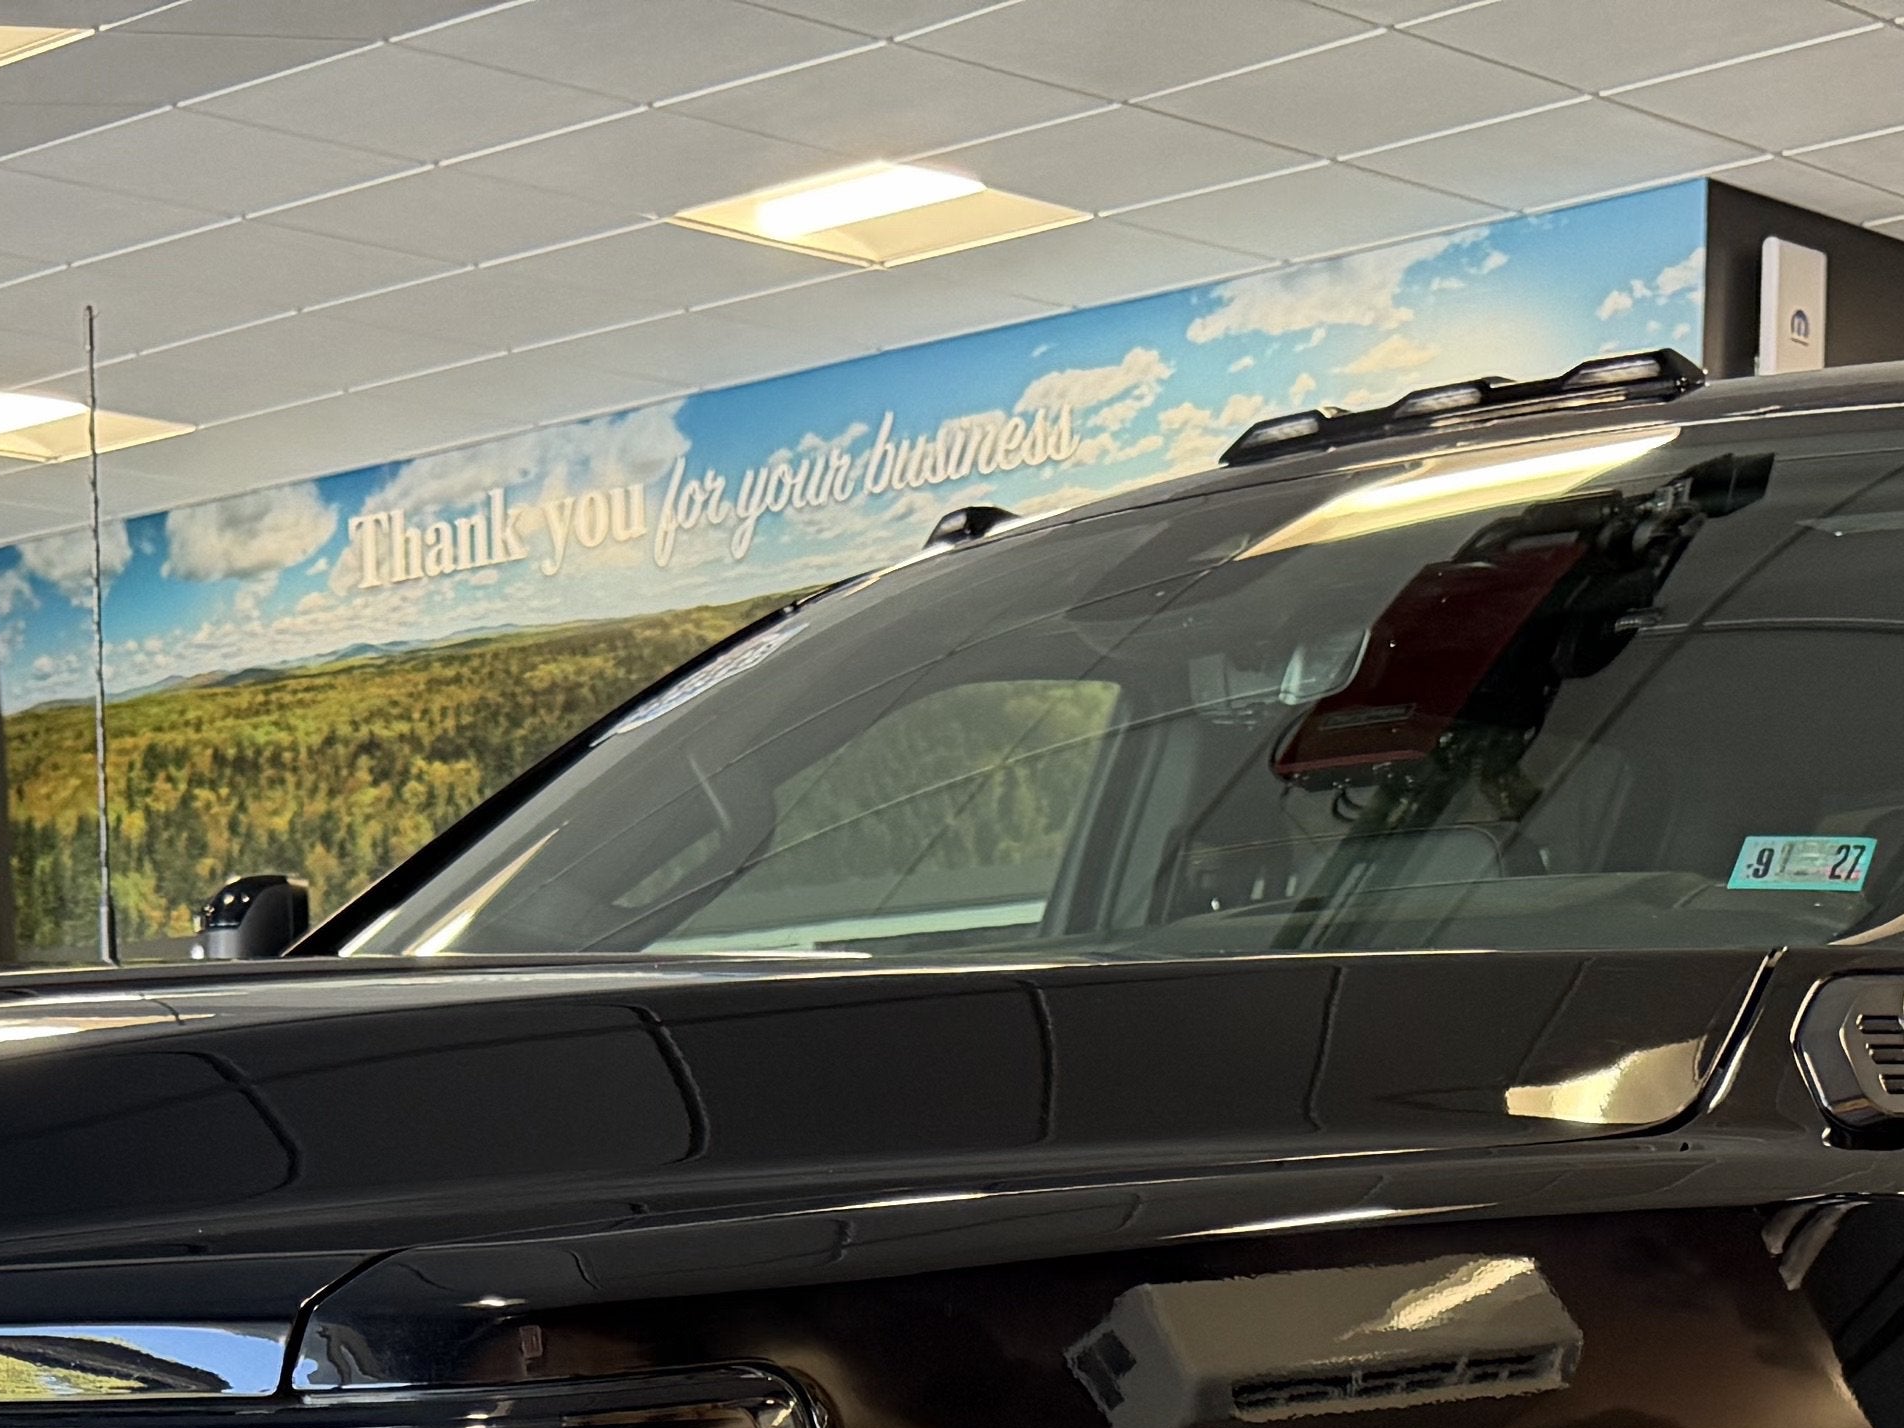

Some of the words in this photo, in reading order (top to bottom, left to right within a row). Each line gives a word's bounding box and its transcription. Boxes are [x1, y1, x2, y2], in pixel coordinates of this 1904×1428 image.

[348, 487, 529, 588] Thank
[540, 483, 647, 576] you
[654, 454, 726, 567] for
[729, 445, 855, 560] your
[864, 402, 1081, 494] business
[1828, 844, 1867, 881] 27
